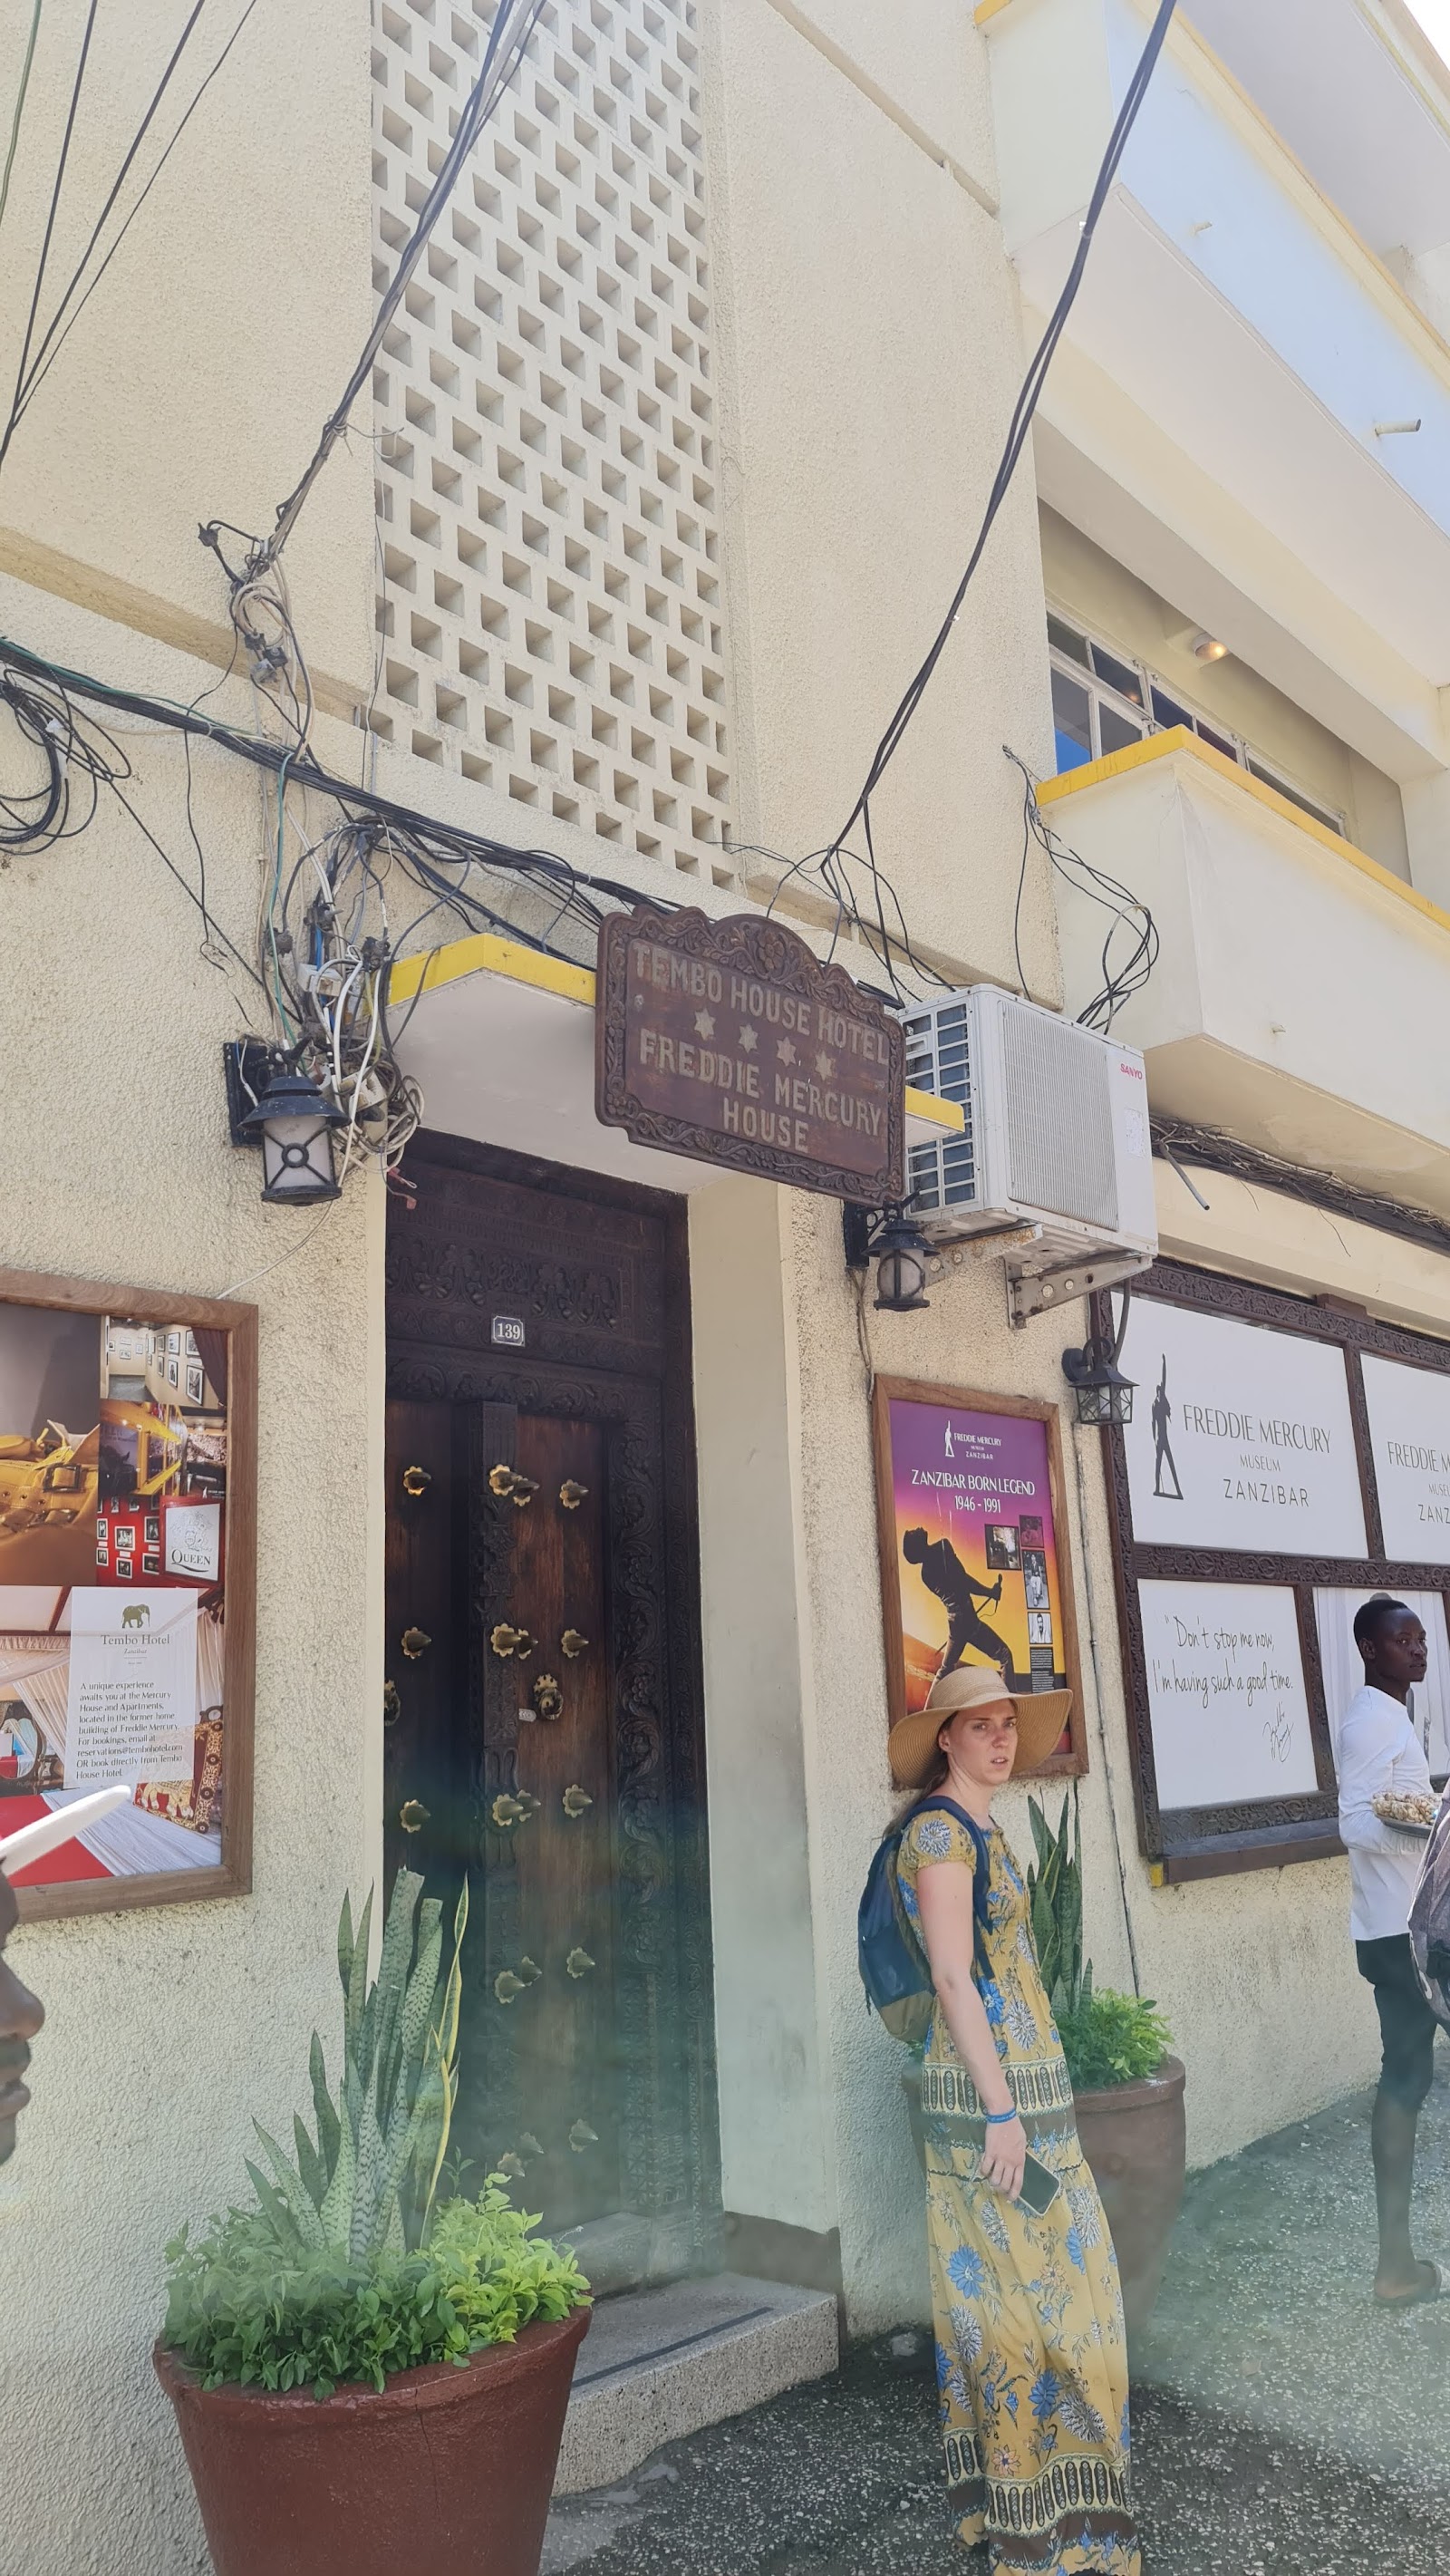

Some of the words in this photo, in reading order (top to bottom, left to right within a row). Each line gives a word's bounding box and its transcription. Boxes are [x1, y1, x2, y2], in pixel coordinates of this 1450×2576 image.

[634, 944, 723, 1003] TEMBO
[730, 976, 812, 1037] HOUSE
[818, 1004, 890, 1066] HOTEL
[1120, 1063, 1143, 1080] SANYO
[640, 1029, 760, 1099] FREDDIE
[774, 1073, 882, 1138] MERCURY
[724, 1097, 809, 1154] HOUSE
[498, 1322, 521, 1340] 139
[1184, 1404, 1255, 1442] FREDDIE
[1259, 1418, 1331, 1454] MERCURY
[954, 1432, 976, 1443] FREDDIE
[977, 1436, 1002, 1447] MERCURY
[965, 1450, 994, 1460] ZANZIBAR
[1240, 1454, 1281, 1473] MUSEUM
[1387, 1441, 1439, 1472] FREDDIE
[912, 1468, 966, 1489] ZANZIBAR
[968, 1475, 997, 1491] BORN
[998, 1478, 1036, 1496] LEGEND
[1223, 1478, 1310, 1507] ZANZIBAR
[954, 1495, 976, 1512] 1946
[983, 1497, 1000, 1514] 1991
[171, 1548, 211, 1573] QUEEN
[101, 1634, 138, 1645] Tembo
[141, 1633, 169, 1645] Hotel
[1213, 1627, 1238, 1664] stop
[1241, 1632, 1253, 1648] me
[1255, 1632, 1275, 1652] now,
[89, 1682, 114, 1692] unique
[116, 1680, 154, 1691] experience
[1153, 1659, 1172, 1693] I'm
[1173, 1659, 1209, 1709] having
[1211, 1658, 1234, 1694] such
[1237, 1676, 1244, 1690] a
[1247, 1661, 1268, 1708] good
[1270, 1670, 1294, 1691] time.
[79, 1693, 103, 1701] awaits
[105, 1693, 118, 1701] you
[129, 1691, 140, 1700] the
[141, 1691, 172, 1700] Mercury
[80, 1704, 103, 1712] House
[104, 1703, 119, 1711] and
[120, 1702, 164, 1712] Apartments,
[79, 1714, 106, 1723] located
[107, 1714, 114, 1722] in
[116, 1713, 128, 1722] the
[130, 1712, 153, 1721] former
[156, 1711, 175, 1720] home
[78, 1726, 109, 1735] building
[111, 1725, 118, 1733] of
[120, 1724, 148, 1733] Freddie
[149, 1723, 180, 1731] Mercury.
[78, 1738, 90, 1746] For
[92, 1736, 127, 1746] bookings,
[128, 1735, 148, 1743] email
[76, 1759, 89, 1767] OR
[91, 1758, 109, 1767] book
[111, 1757, 139, 1766] directly
[140, 1756, 158, 1764] from
[160, 1754, 182, 1763] Tembo
[76, 1770, 100, 1780] House
